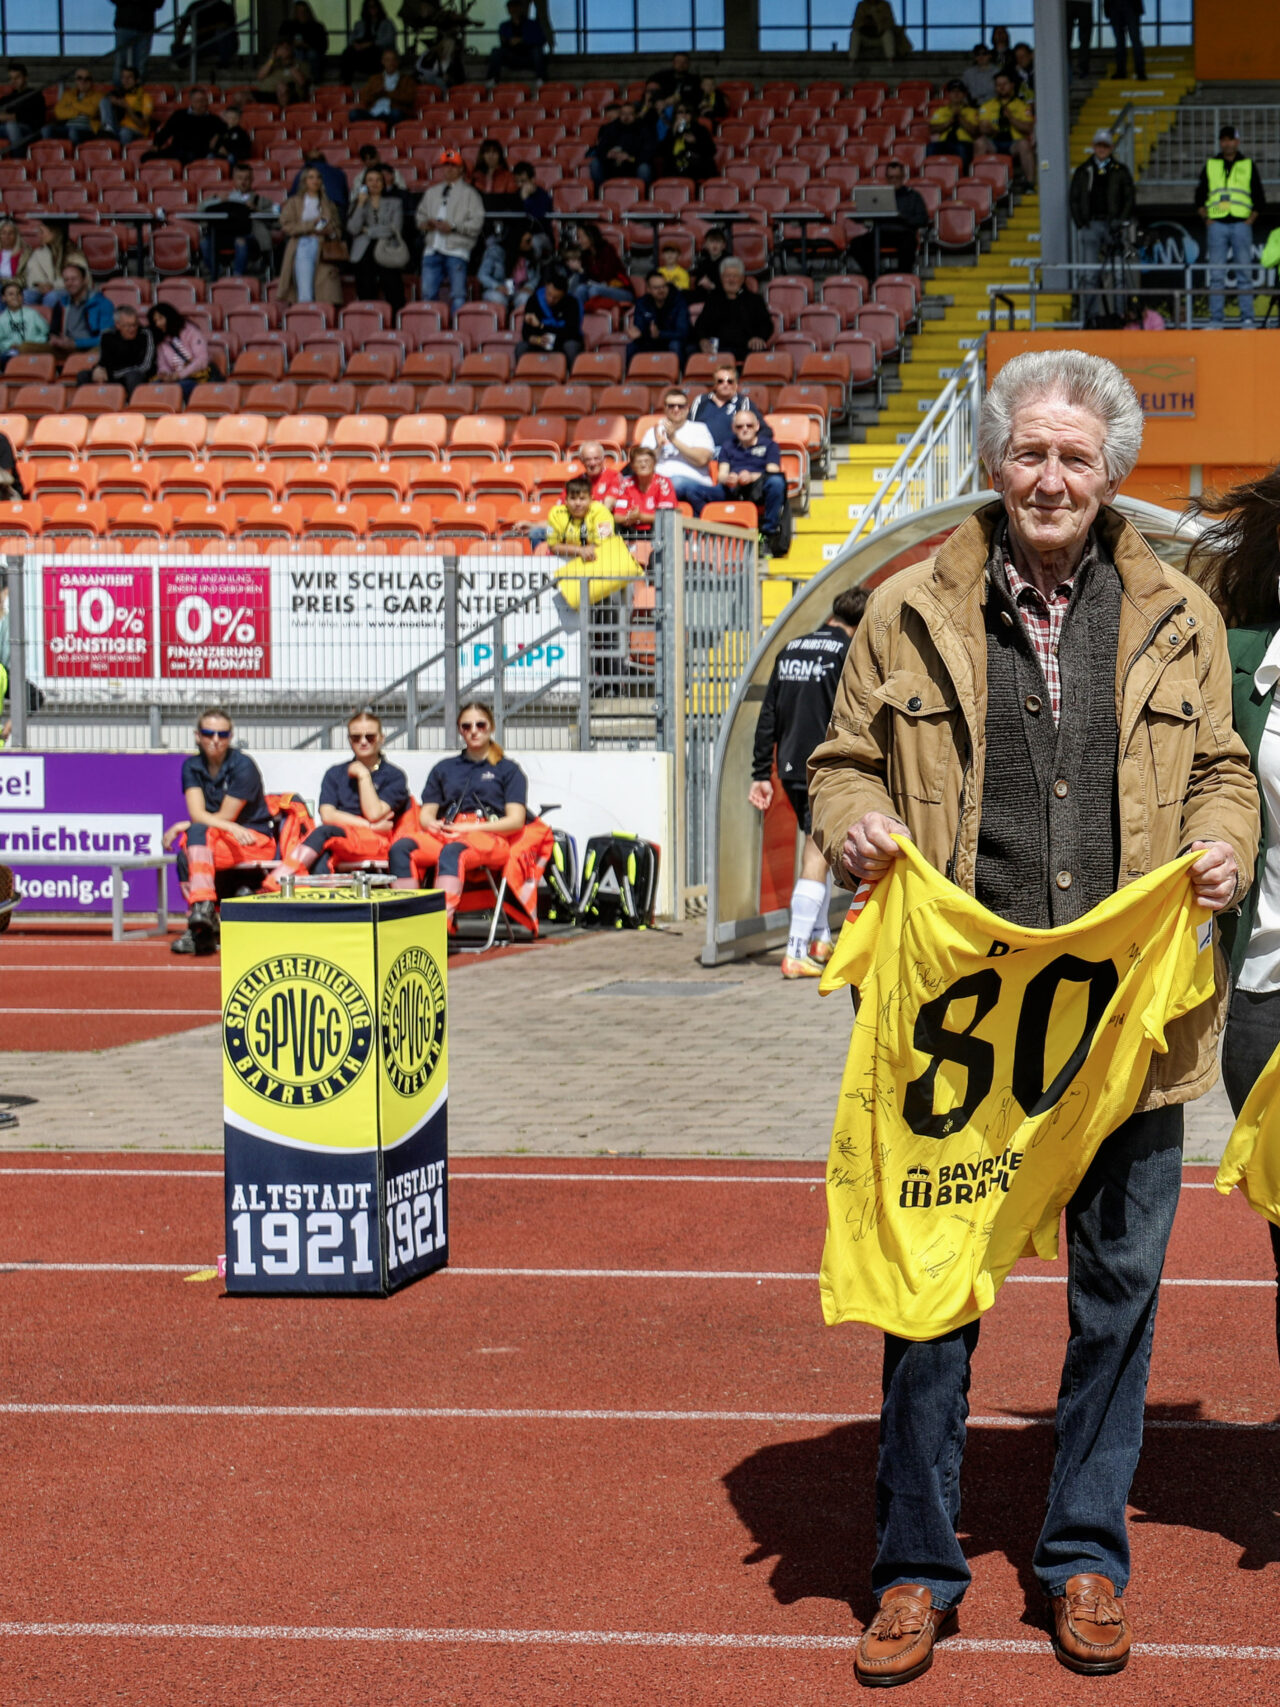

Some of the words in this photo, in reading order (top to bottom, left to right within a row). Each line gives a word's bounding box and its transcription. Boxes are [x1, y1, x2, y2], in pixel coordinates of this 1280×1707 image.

[1140, 393, 1195, 410] EUTH
[60, 574, 134, 586] GARANTIERT
[291, 572, 338, 589] WIR
[349, 572, 475, 590] SCHLAGN
[59, 588, 144, 634] 10%
[176, 595, 256, 644] 0%
[292, 596, 355, 613] PREIS
[50, 634, 147, 653] GÜNSTIGER
[167, 646, 263, 658] FINANZIERUNG
[207, 658, 261, 670] MONATE
[226, 958, 371, 1029] SPIELVEREINIGUNG
[382, 950, 445, 1026] SPIELVEREINIGUNG
[255, 987, 342, 1077] SPVGG
[393, 979, 431, 1066] SPVGG
[902, 953, 1119, 1139] 80
[235, 1054, 363, 1104] BAYREUTH
[385, 1041, 441, 1094] BAYREUTH
[231, 1183, 372, 1210] ALTSTADT
[386, 1160, 445, 1206] ALTSTADT
[232, 1211, 374, 1275] 1921
[386, 1187, 446, 1271] 1921
